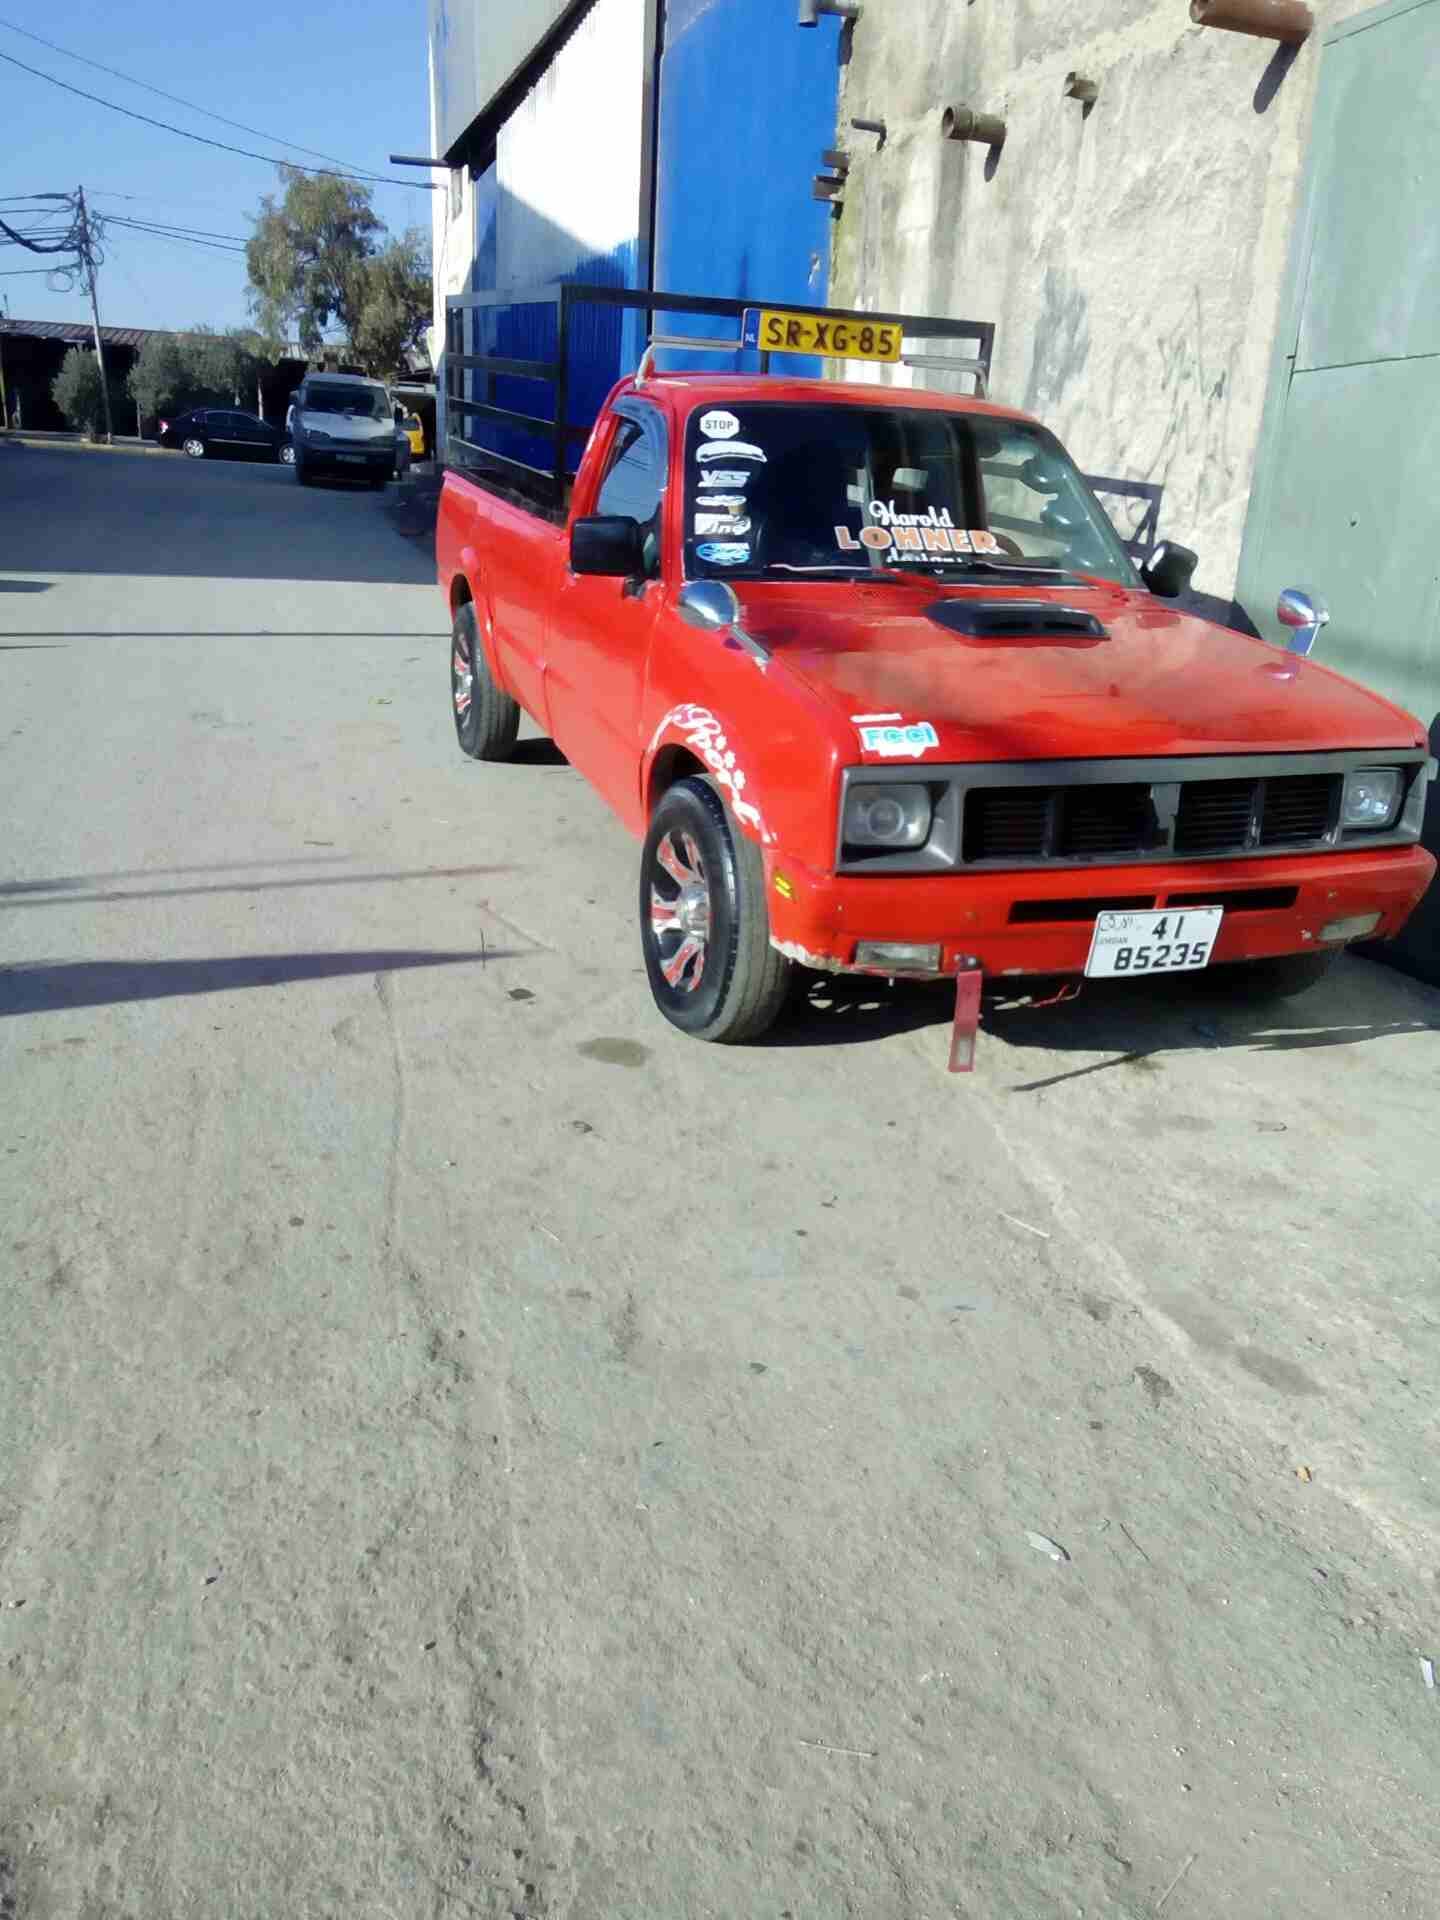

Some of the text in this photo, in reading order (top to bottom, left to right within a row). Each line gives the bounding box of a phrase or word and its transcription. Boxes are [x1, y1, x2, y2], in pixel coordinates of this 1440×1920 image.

[766, 317, 894, 356] SR-XG-85
[704, 419, 735, 430] STOP
[868, 499, 955, 528] Harold
[833, 525, 1009, 555] LOHNER
[1152, 915, 1185, 940] 41
[1113, 942, 1209, 971] 85235
